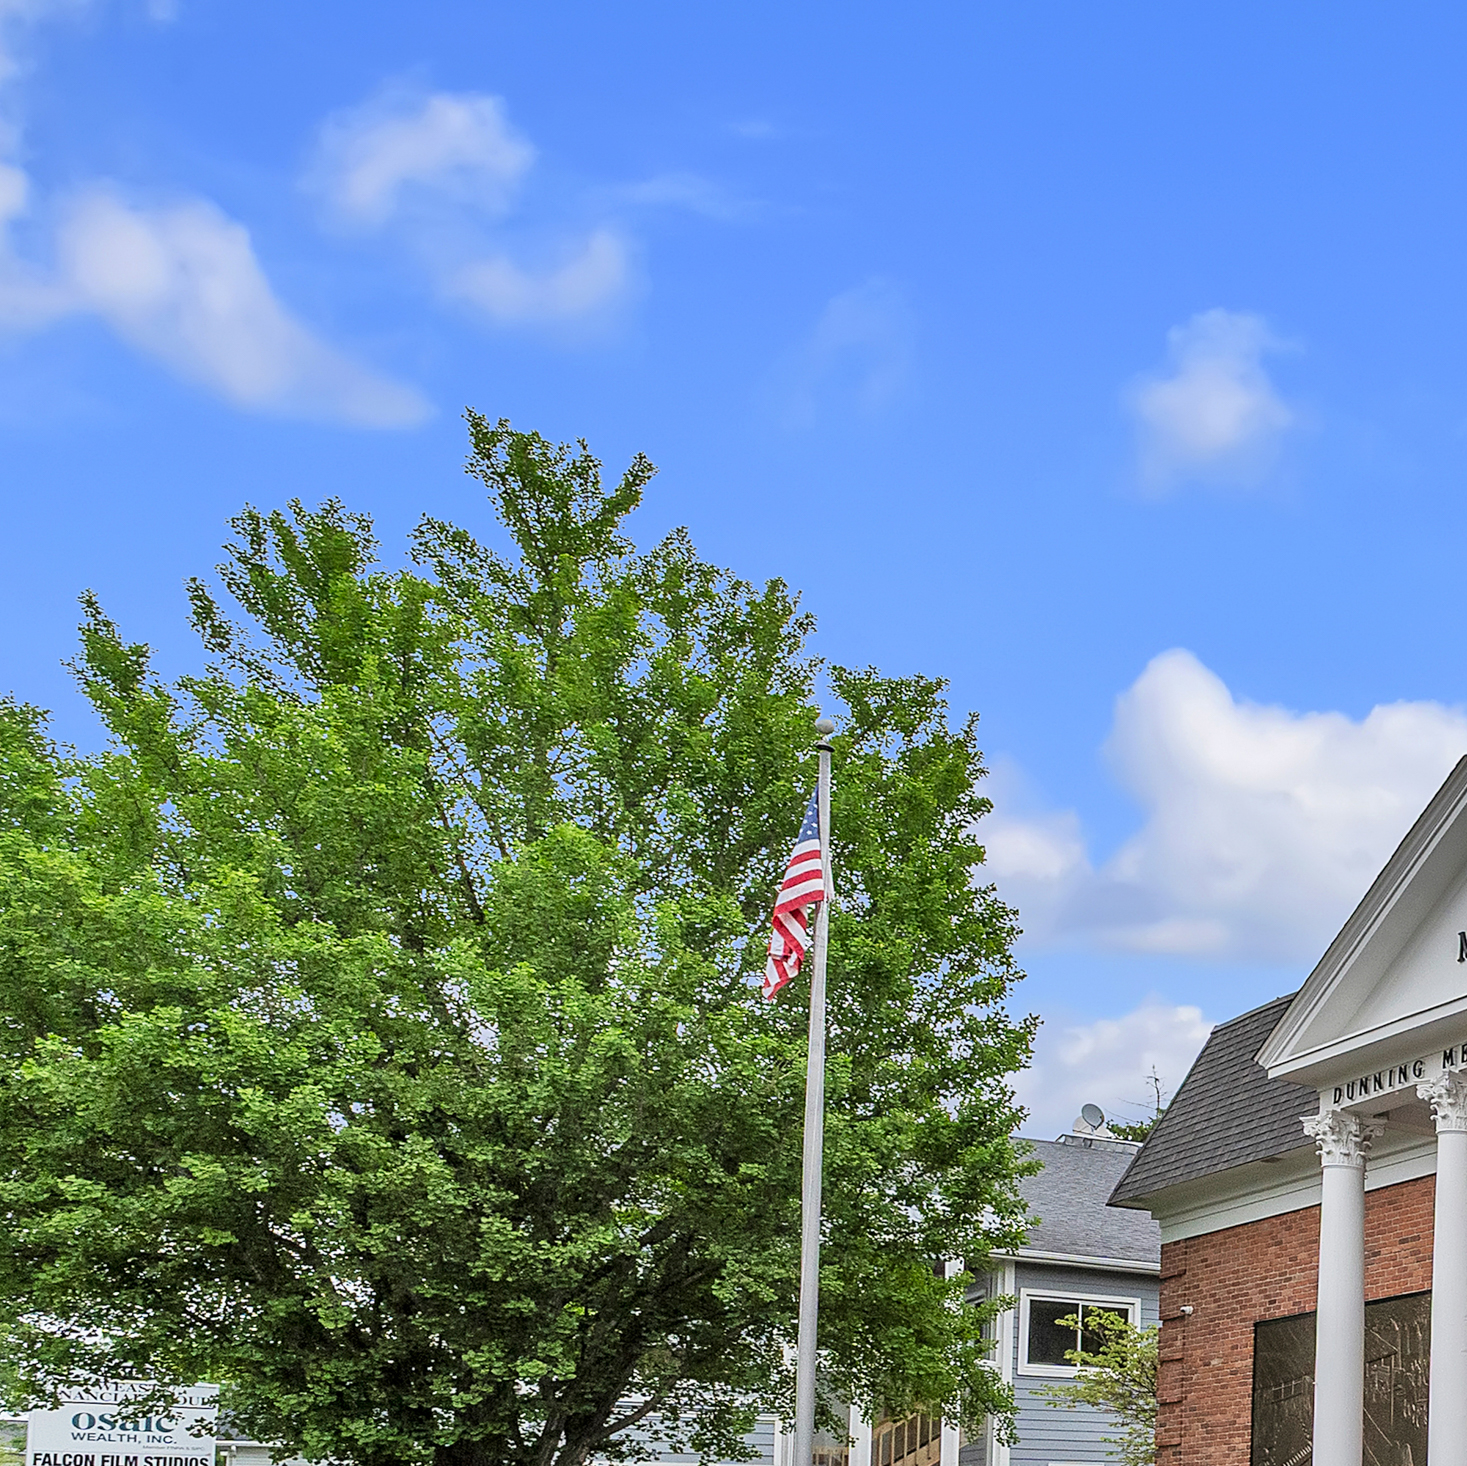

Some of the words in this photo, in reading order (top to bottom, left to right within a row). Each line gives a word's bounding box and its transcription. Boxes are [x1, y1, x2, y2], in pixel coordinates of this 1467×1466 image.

[1333, 1060, 1425, 1104] DUNNING
[71, 1432, 141, 1444] WEALTH,
[147, 1435, 177, 1444] INC.
[32, 1453, 94, 1466] FALCON
